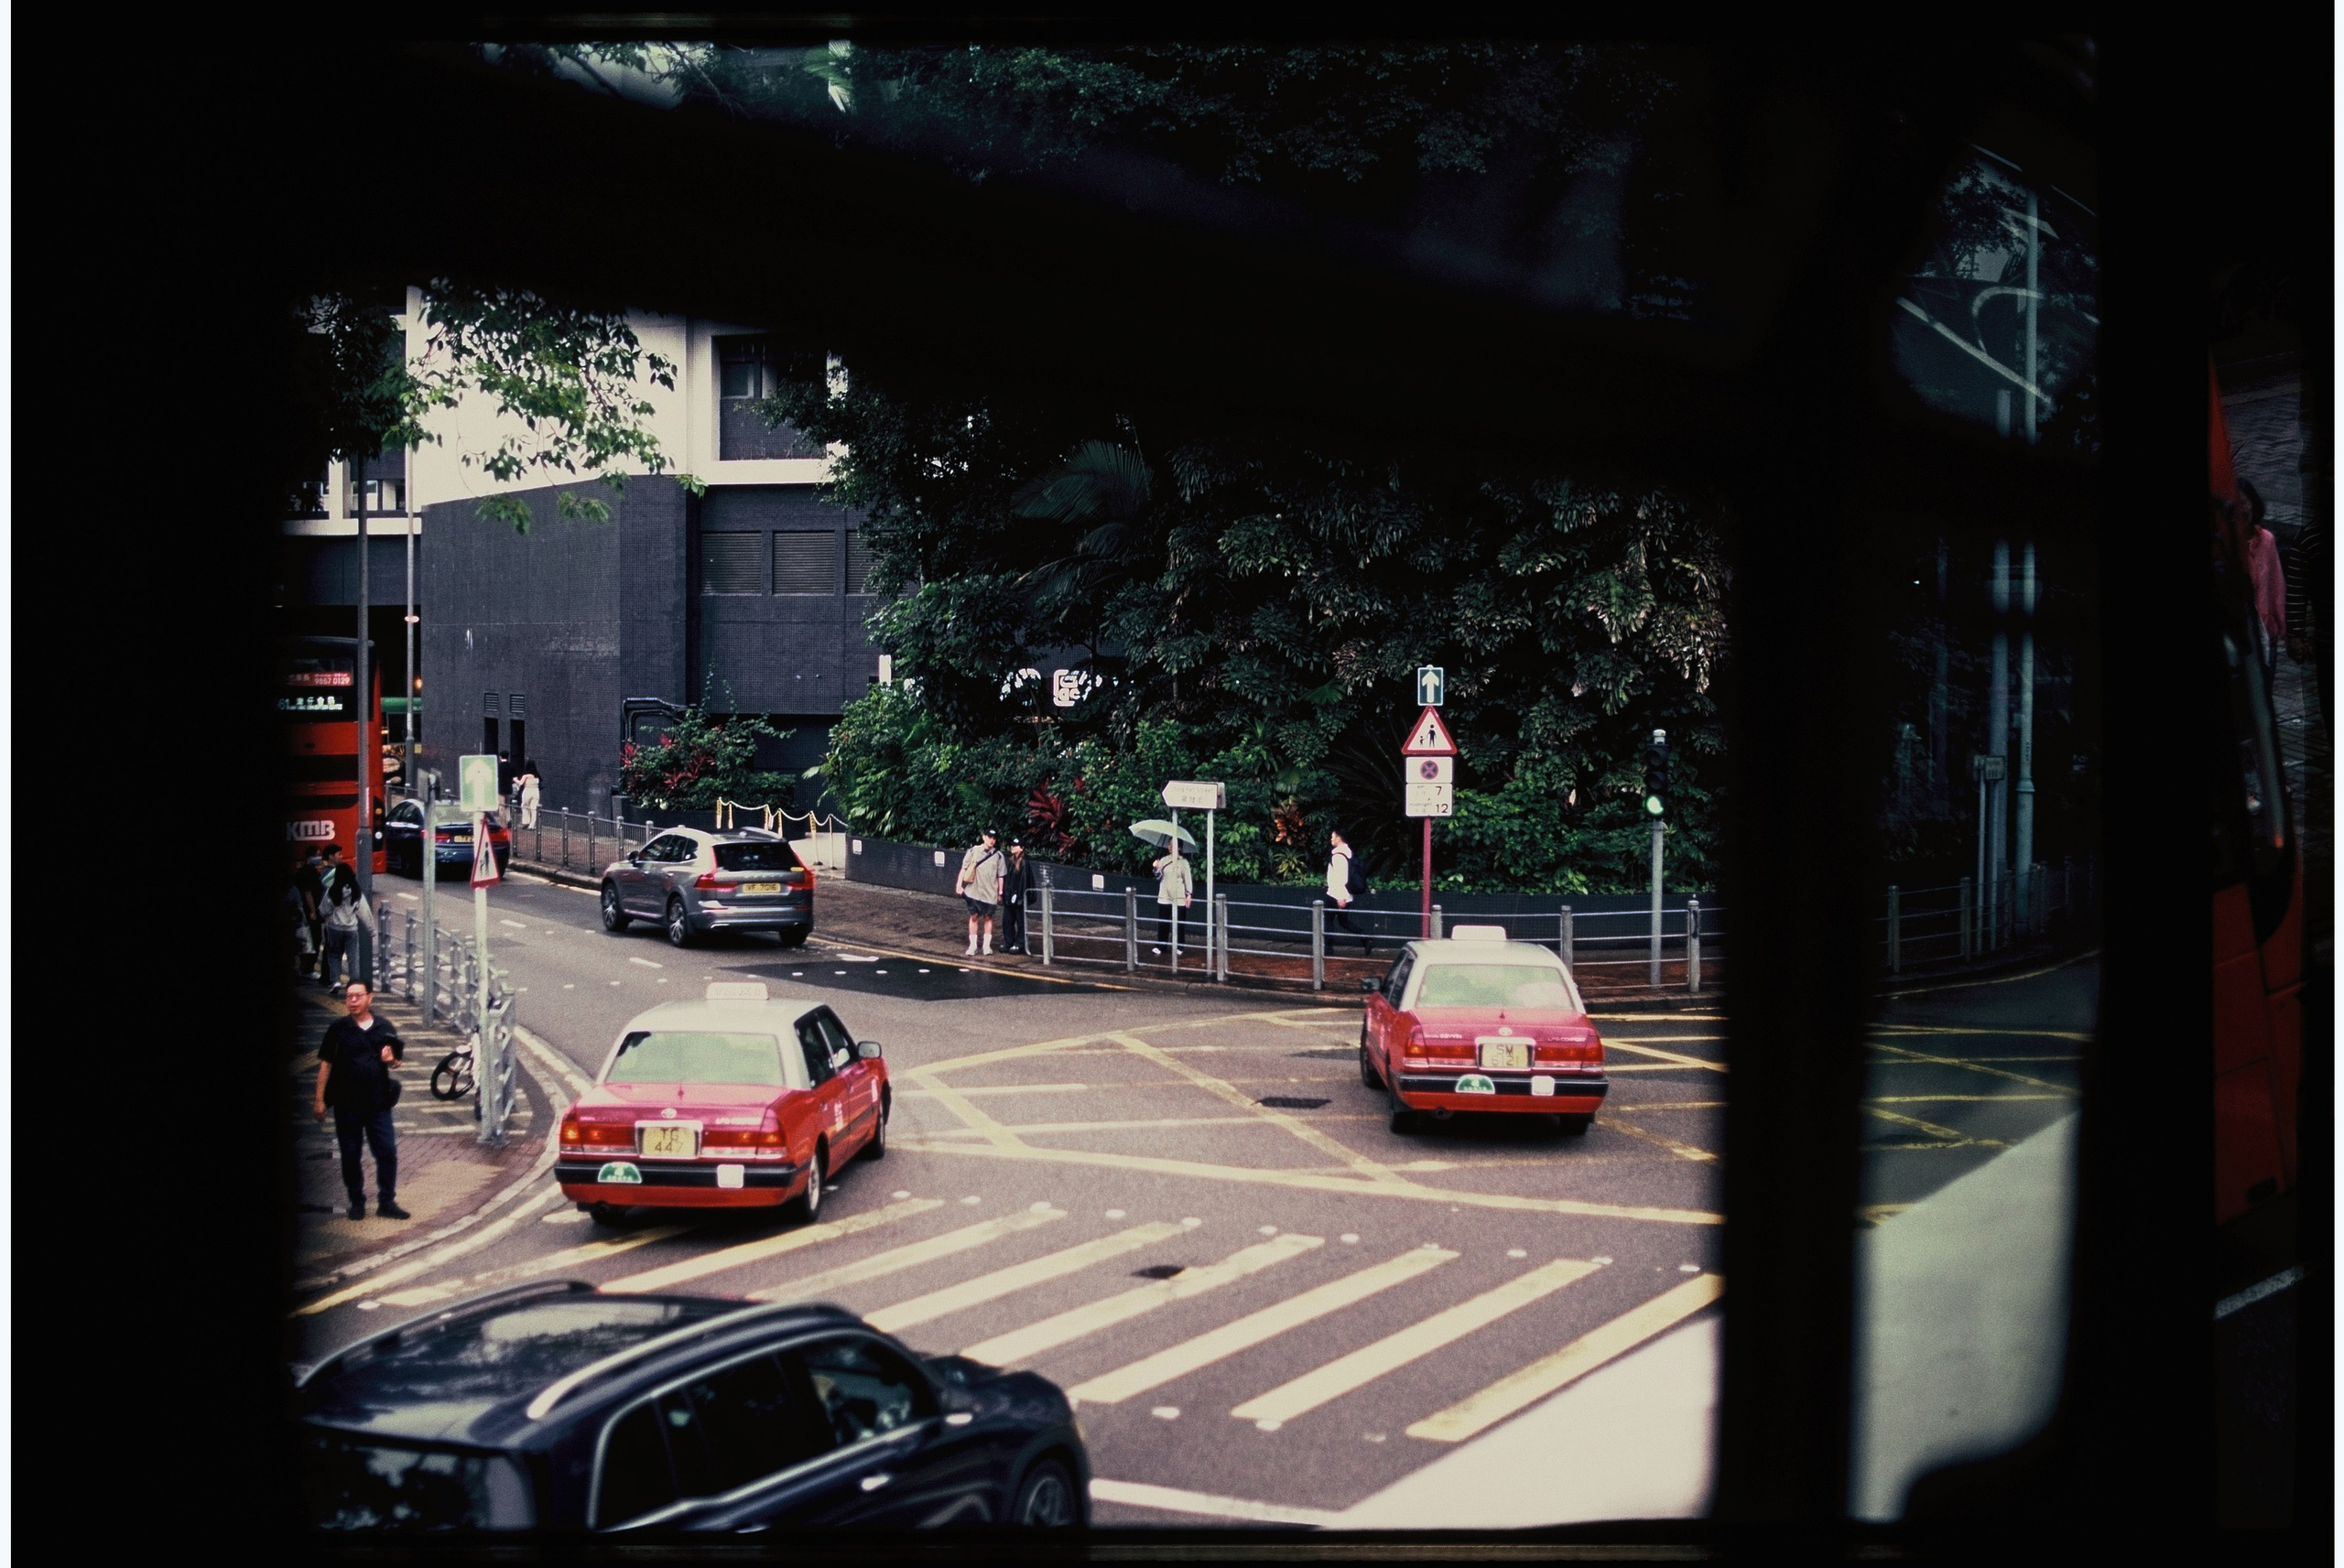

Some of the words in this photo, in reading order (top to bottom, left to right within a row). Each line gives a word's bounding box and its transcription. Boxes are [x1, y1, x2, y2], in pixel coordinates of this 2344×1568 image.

[1435, 785, 1443, 796] 7
[1435, 803, 1449, 814] 12
[286, 819, 336, 841] KMB
[1496, 1044, 1514, 1054] SM
[654, 1141, 684, 1153] 447
